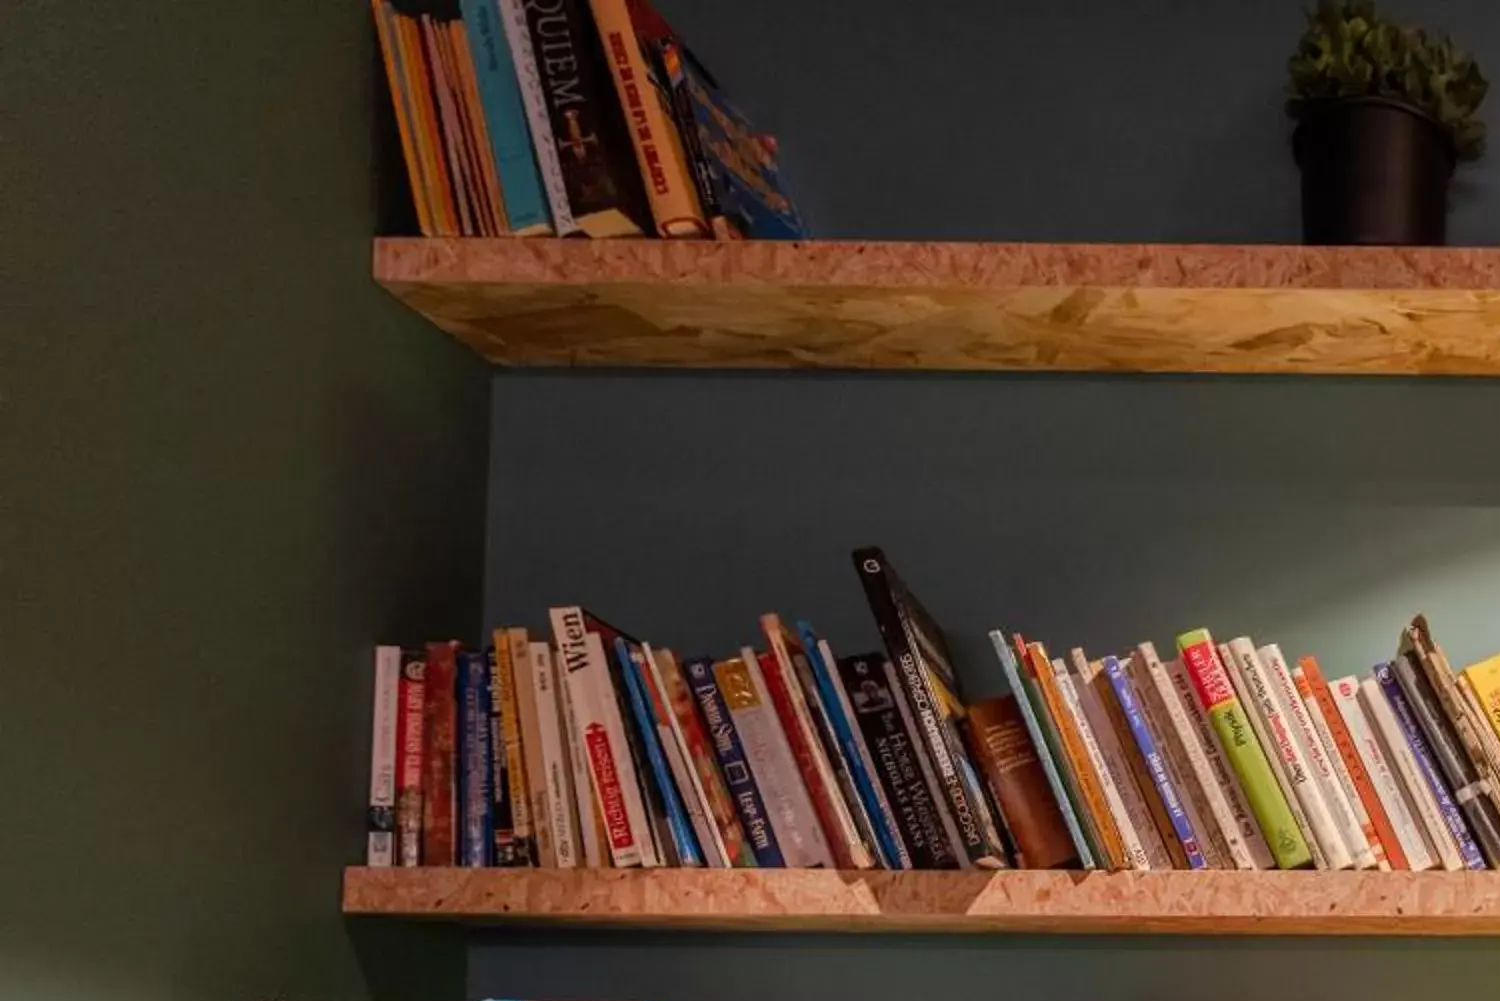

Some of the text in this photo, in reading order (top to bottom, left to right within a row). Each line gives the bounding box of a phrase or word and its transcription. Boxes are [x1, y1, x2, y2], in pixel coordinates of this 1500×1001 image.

[553, 611, 591, 674] Wien
[591, 739, 629, 839] Richtig reisen
[874, 734, 927, 849] NICHOLAS EVANS
